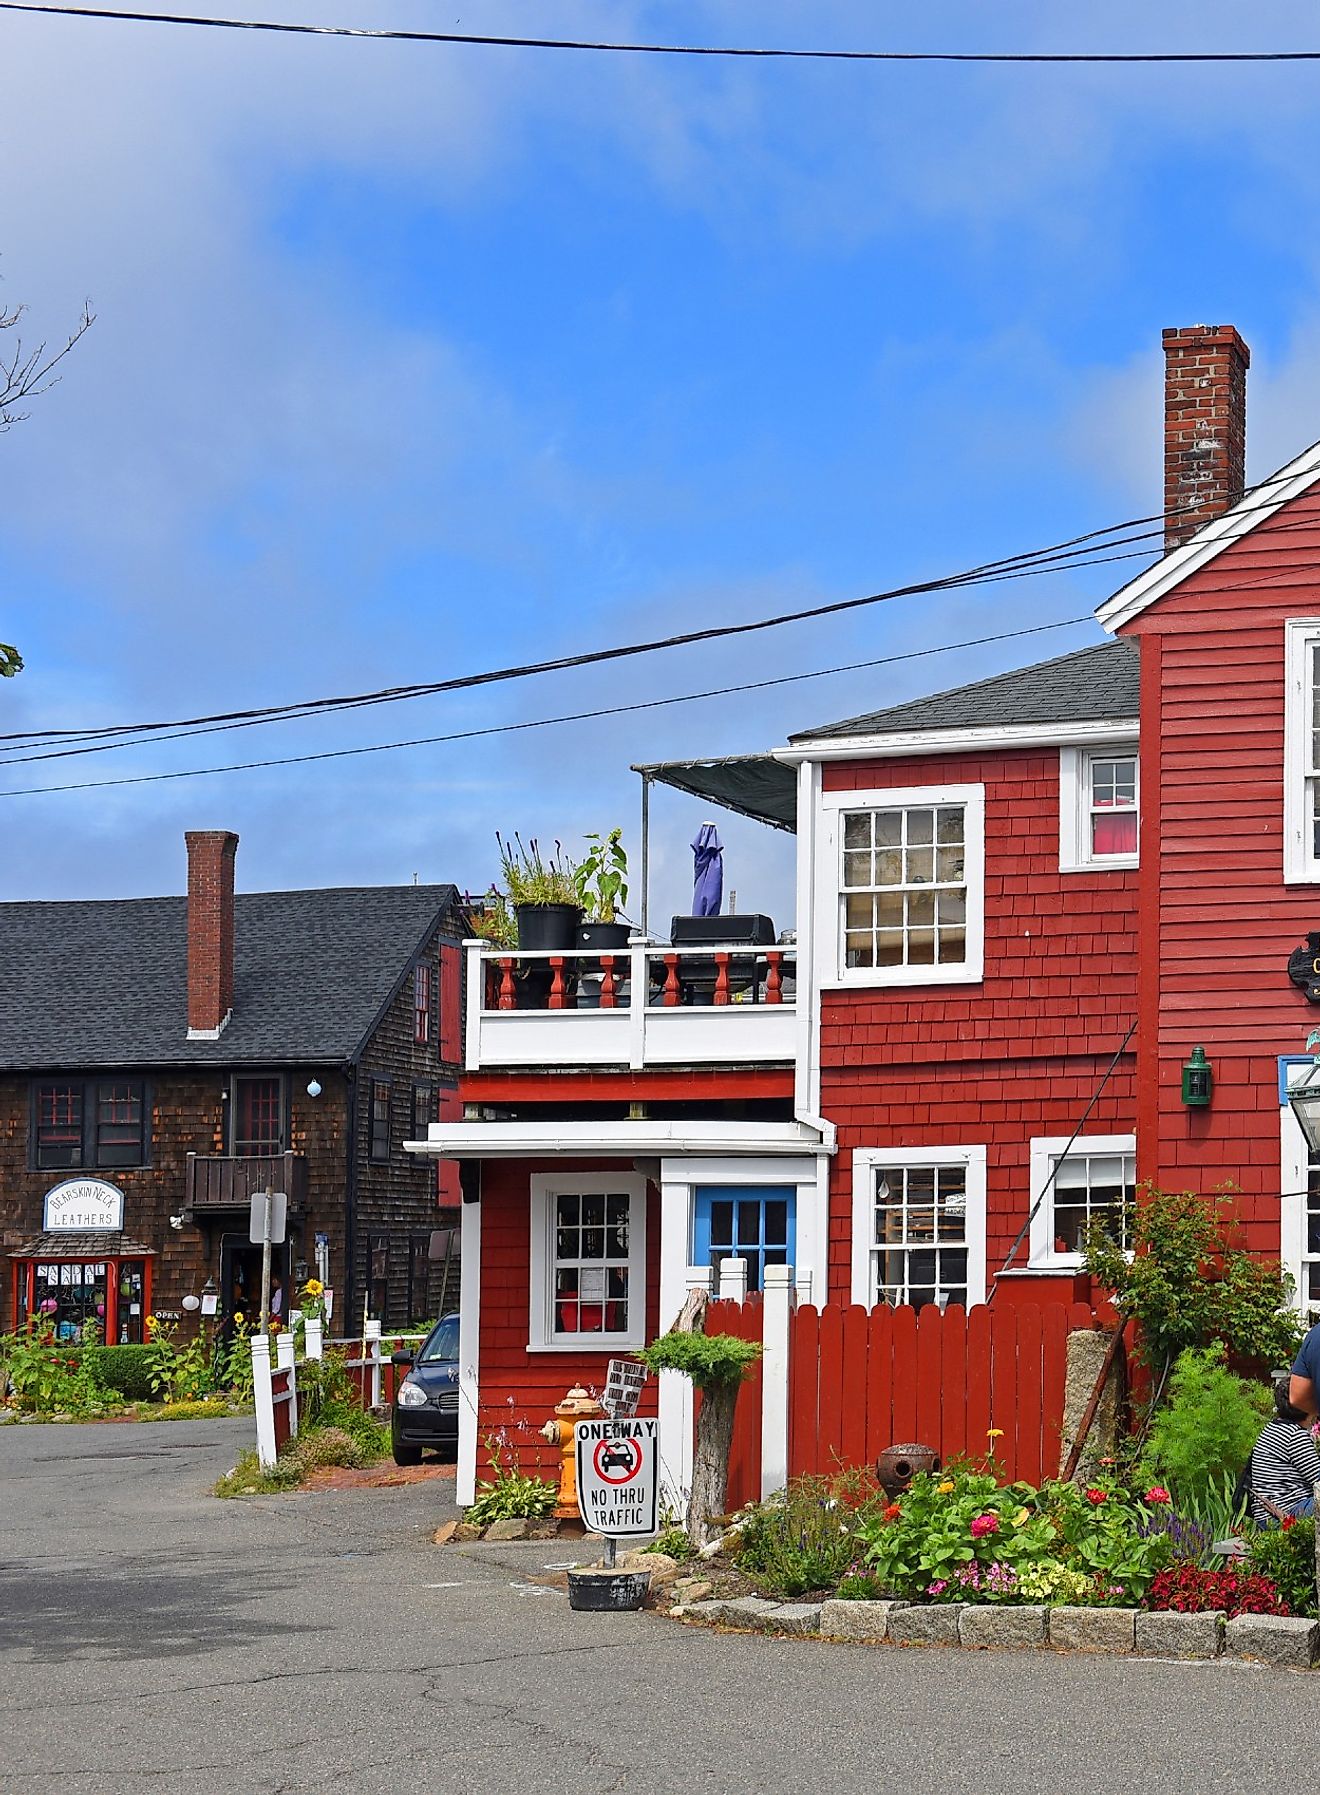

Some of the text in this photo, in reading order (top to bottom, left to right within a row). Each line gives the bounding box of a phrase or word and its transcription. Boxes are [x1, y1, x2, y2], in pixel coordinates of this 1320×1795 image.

[49, 1186, 117, 1210] BEARSKIN NECK
[54, 1213, 112, 1226] LEATHERS
[39, 1265, 104, 1276] SANDAL
[579, 1421, 655, 1440] ONE WAY
[591, 1487, 645, 1506] NO THRU
[594, 1508, 643, 1526] TRAFFIC
